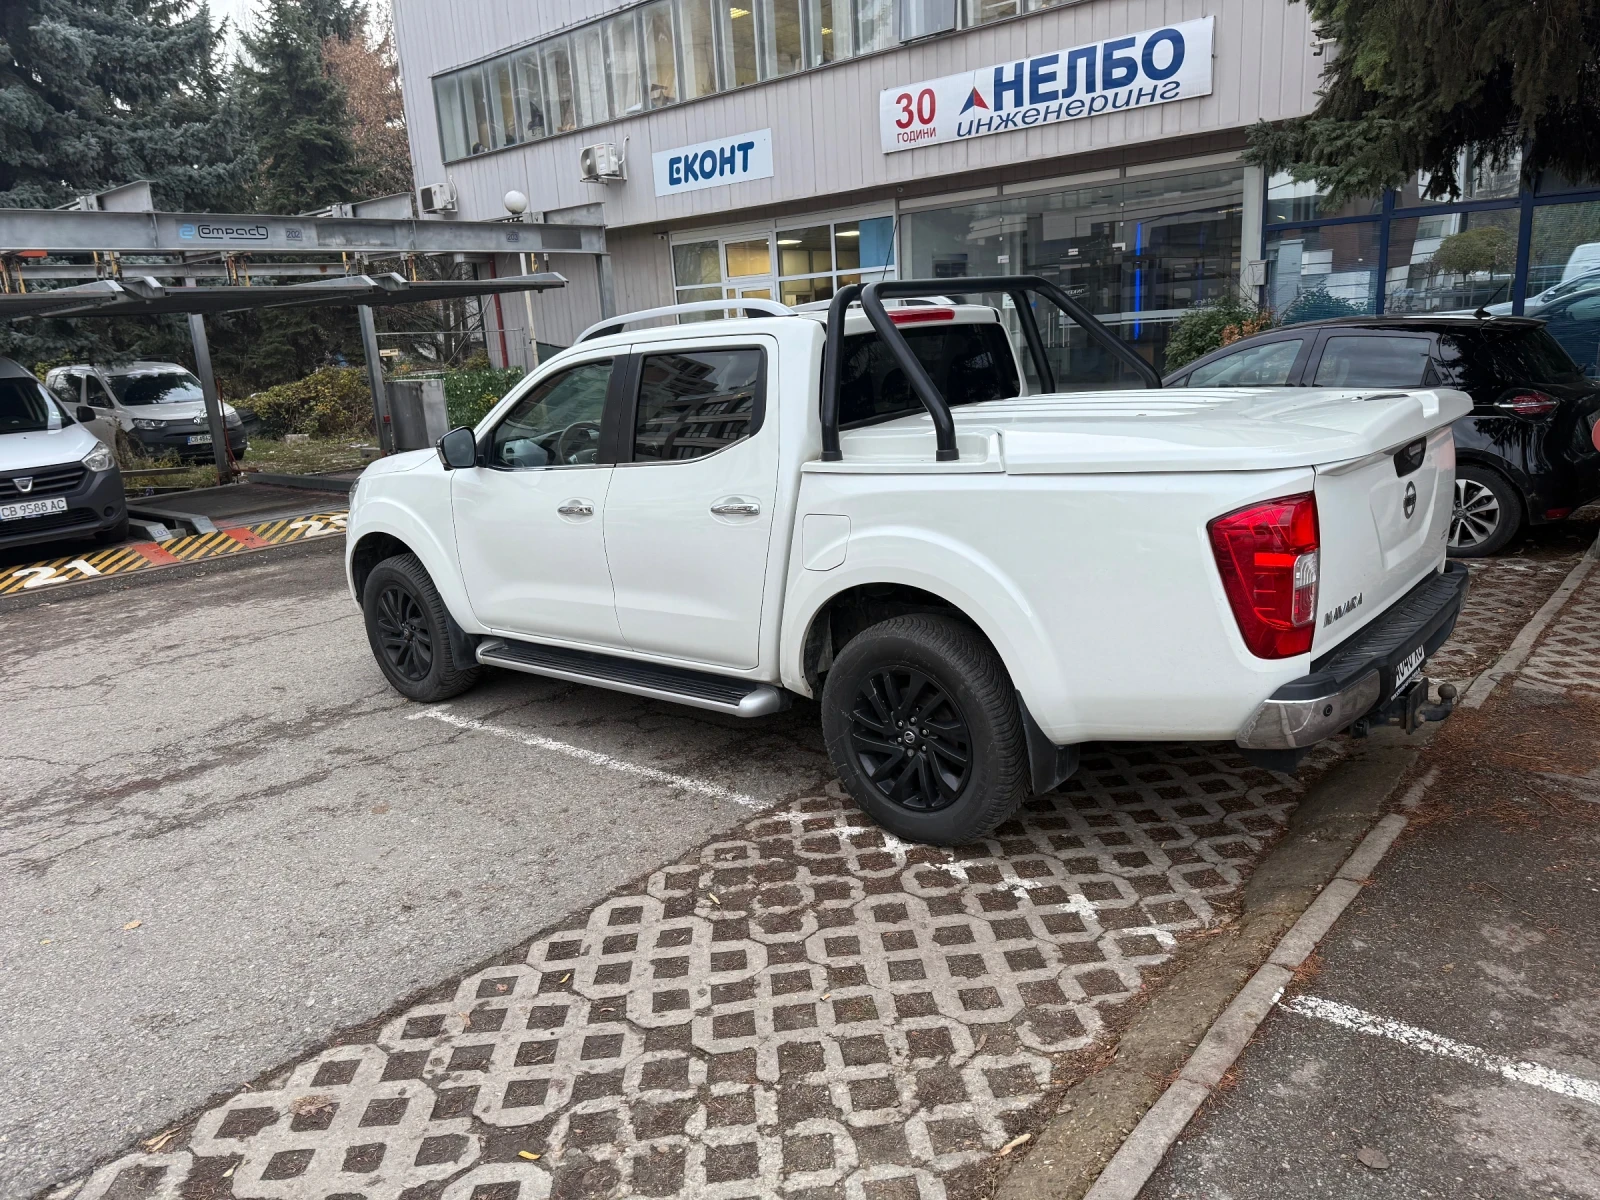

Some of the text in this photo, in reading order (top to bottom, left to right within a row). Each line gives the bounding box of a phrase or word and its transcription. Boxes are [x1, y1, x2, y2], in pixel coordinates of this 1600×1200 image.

[994, 28, 1185, 112] НЕЛБО
[895, 88, 936, 129] 30
[956, 80, 1181, 138] инженеринг
[897, 126, 937, 144] ГОДИНИ
[668, 141, 755, 186] ЕКОНТ
[286, 230, 301, 239] 202
[1, 507, 18, 517] CB
[20, 502, 48, 515] 9588
[51, 499, 65, 511] AC
[12, 559, 101, 588] 21
[1323, 592, 1363, 628] NAVARA
